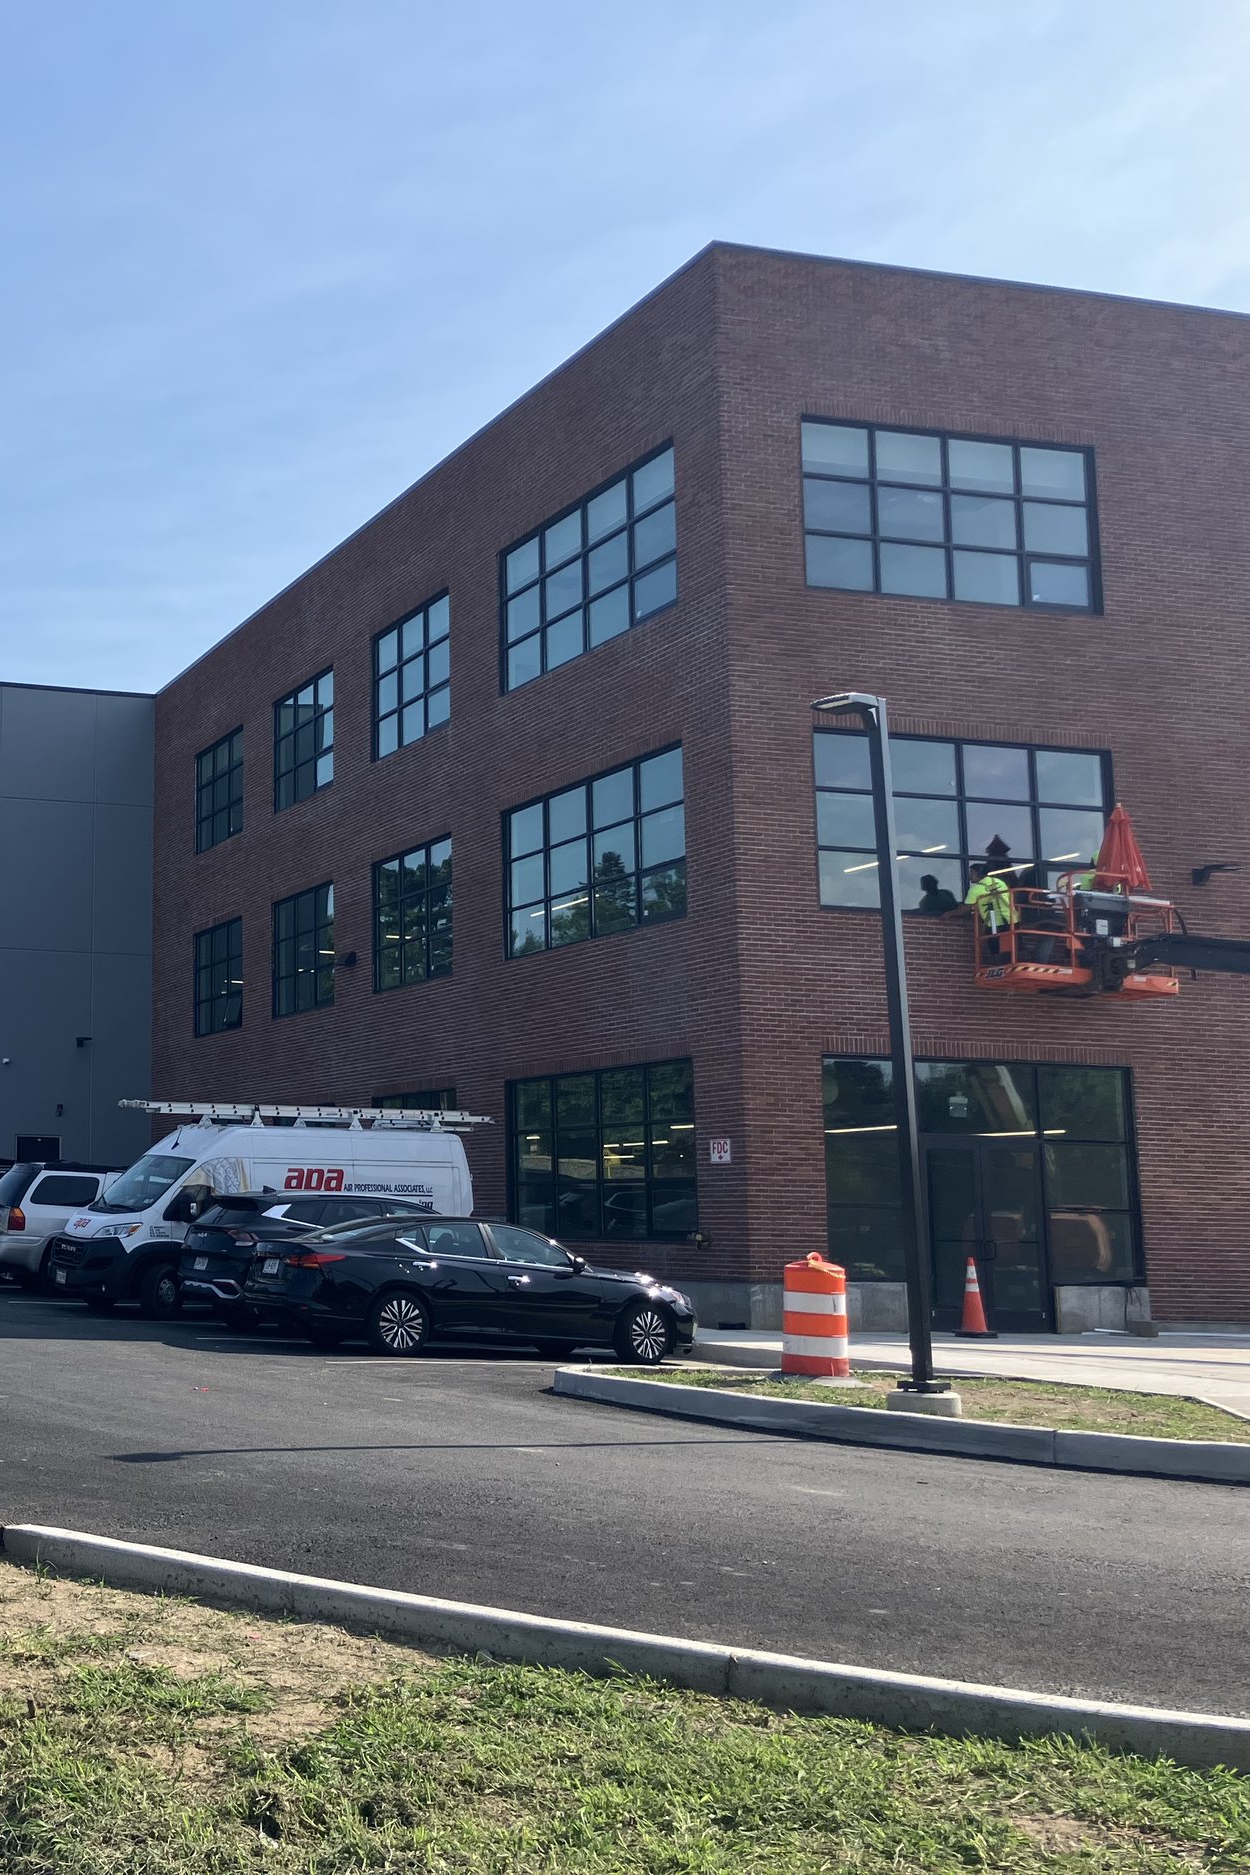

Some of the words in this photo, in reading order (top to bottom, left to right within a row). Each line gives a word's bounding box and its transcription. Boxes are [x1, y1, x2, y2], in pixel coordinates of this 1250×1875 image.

[712, 1141, 728, 1154] FDC
[344, 1183, 354, 1192] AIR
[354, 1183, 393, 1193] PROFESSIONAL
[393, 1184, 426, 1194] ASSOCIATES,
